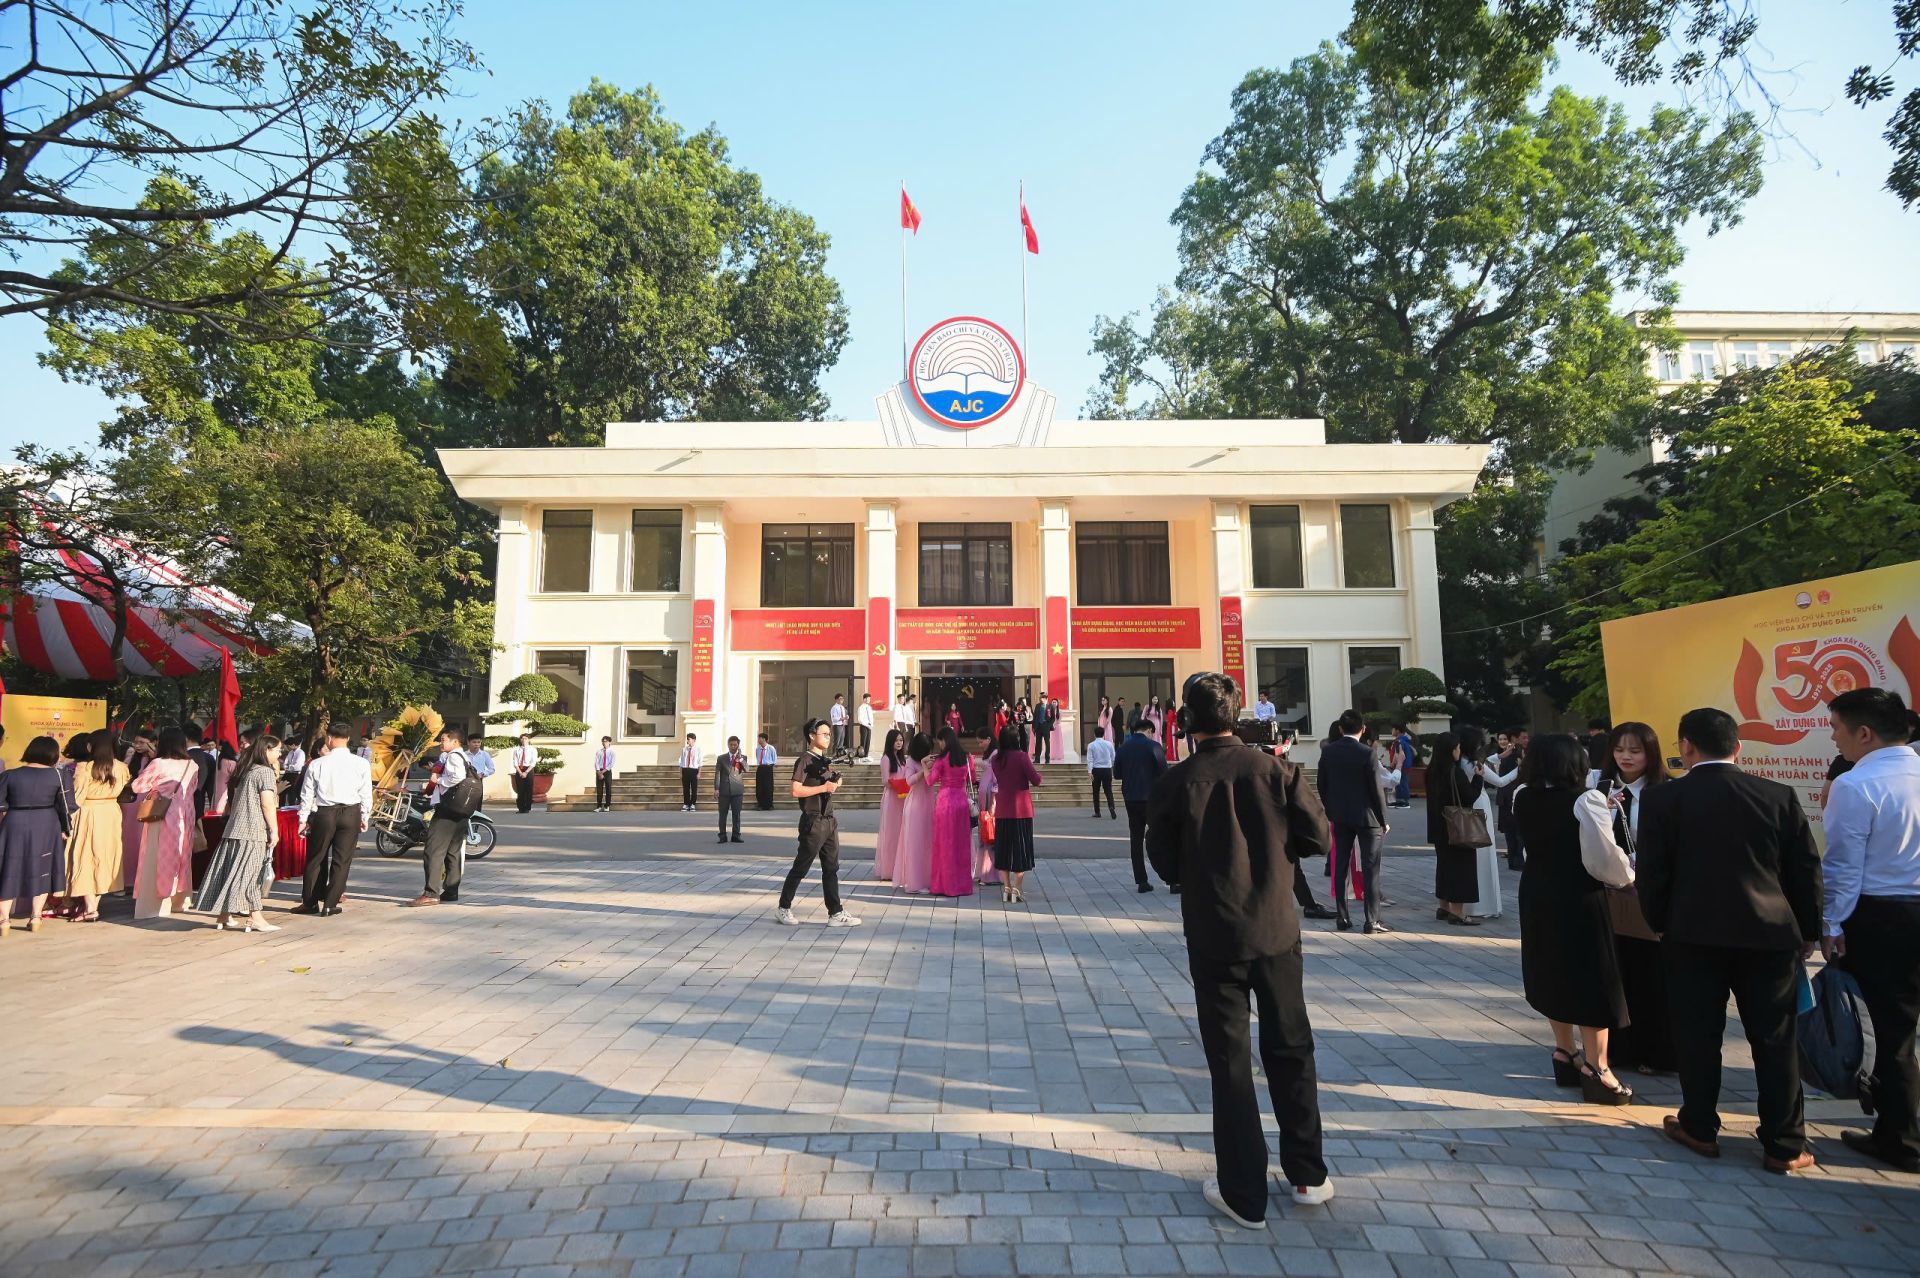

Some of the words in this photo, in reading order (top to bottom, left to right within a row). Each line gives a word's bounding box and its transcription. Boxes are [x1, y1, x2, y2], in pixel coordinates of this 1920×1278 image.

[949, 399, 985, 413] AJC
[1776, 625, 1796, 633] KHOA
[1797, 622, 1810, 630] XÂY
[1823, 636, 1843, 646] KHOA
[1844, 636, 1858, 645] XÂY
[1811, 683, 1822, 701] 1975
[1820, 663, 1834, 681] 2025
[1775, 716, 1791, 729] XÂY
[1792, 717, 1816, 730] DỰNG
[1817, 715, 1830, 728] VÀ
[1741, 757, 1753, 766] 50
[1756, 755, 1780, 766] NĂM
[1783, 755, 1822, 767] THÀNH
[1778, 768, 1808, 780] HUÂN
